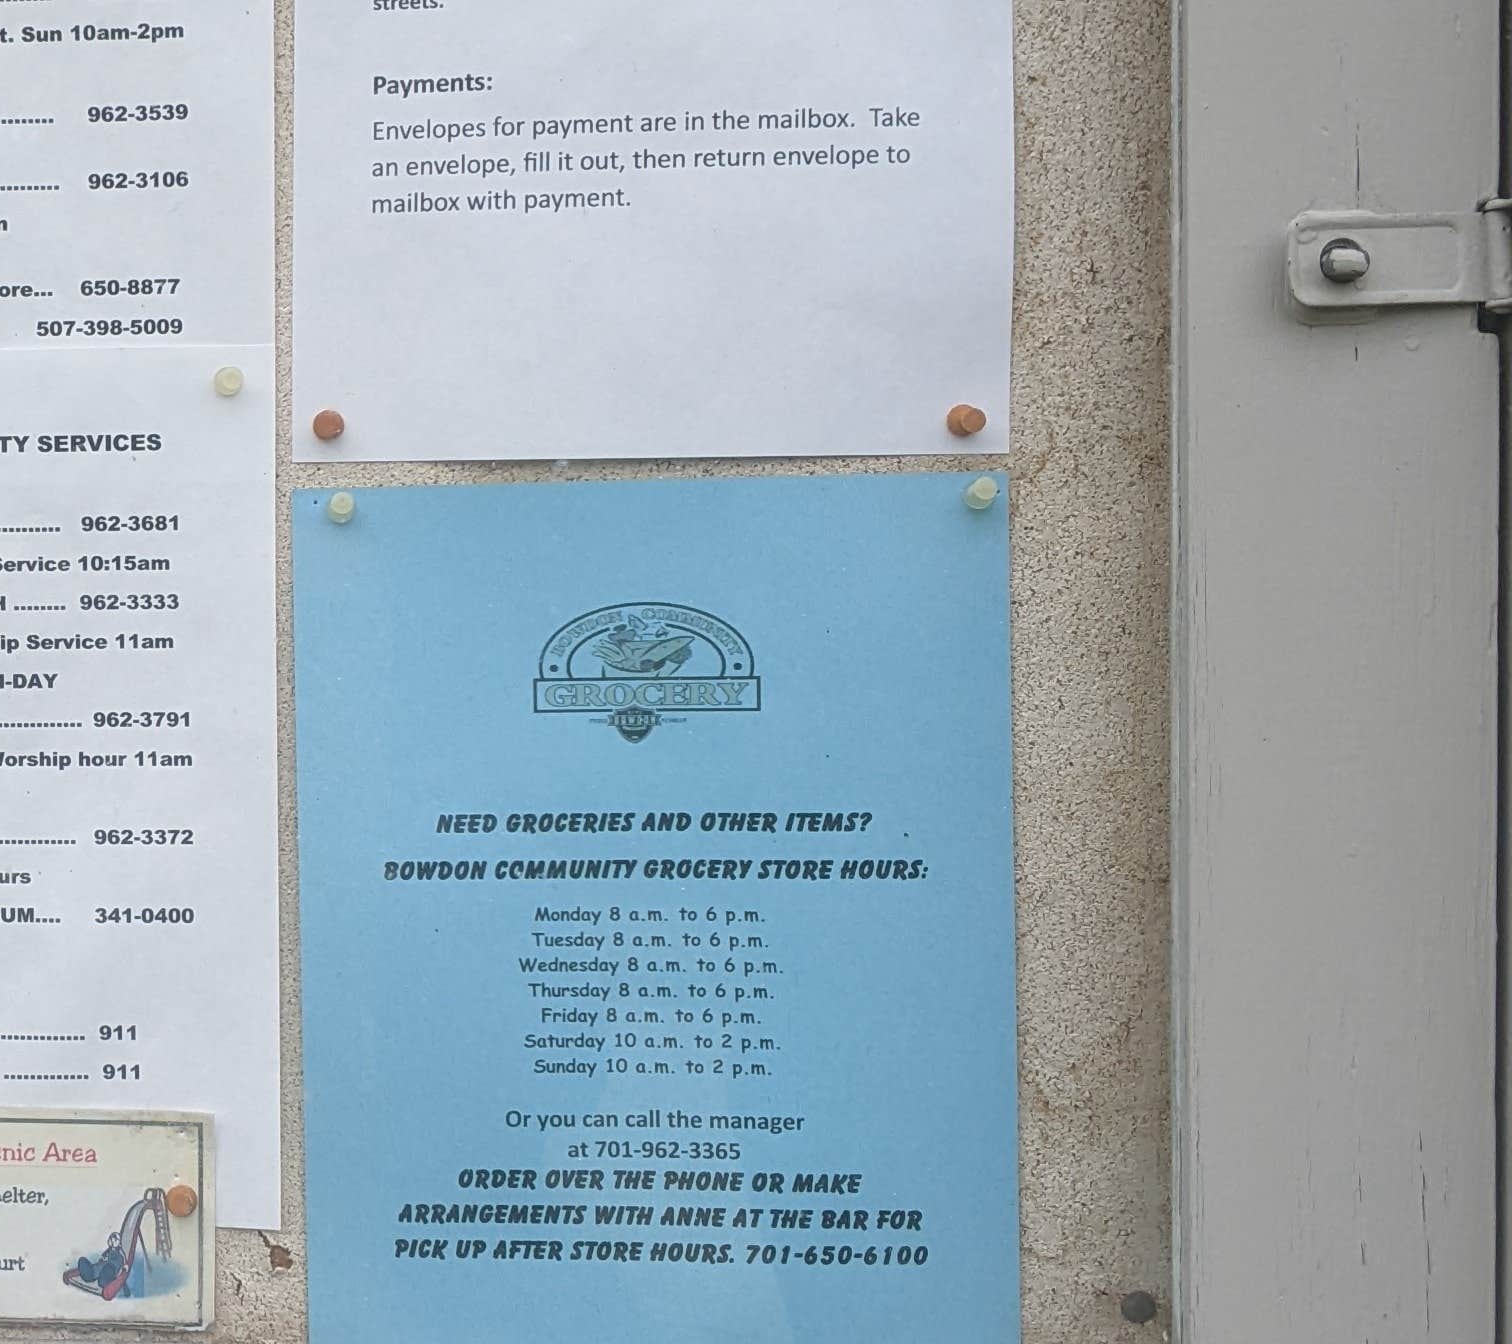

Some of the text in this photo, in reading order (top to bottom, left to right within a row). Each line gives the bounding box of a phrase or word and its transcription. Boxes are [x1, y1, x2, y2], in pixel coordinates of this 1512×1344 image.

[373, 73, 492, 99] Payments:
[36, 432, 163, 455] SERVICES
[77, 555, 170, 571] 10:15am
[544, 682, 750, 707] GROCERY
[436, 811, 872, 834] NEED GROCERIES AND OTHER ITEMS?
[384, 858, 928, 881] BOWDON COMMUNITY GROCERY STORE HOURS:
[534, 905, 765, 926] Monday 8 a.m. to 6 p.m.
[41, 1141, 97, 1163] Area
[567, 1140, 740, 1160] at 701-962-3365
[394, 1238, 930, 1267] PICK UP AFTER STORE HOURS. 701-650-6100
